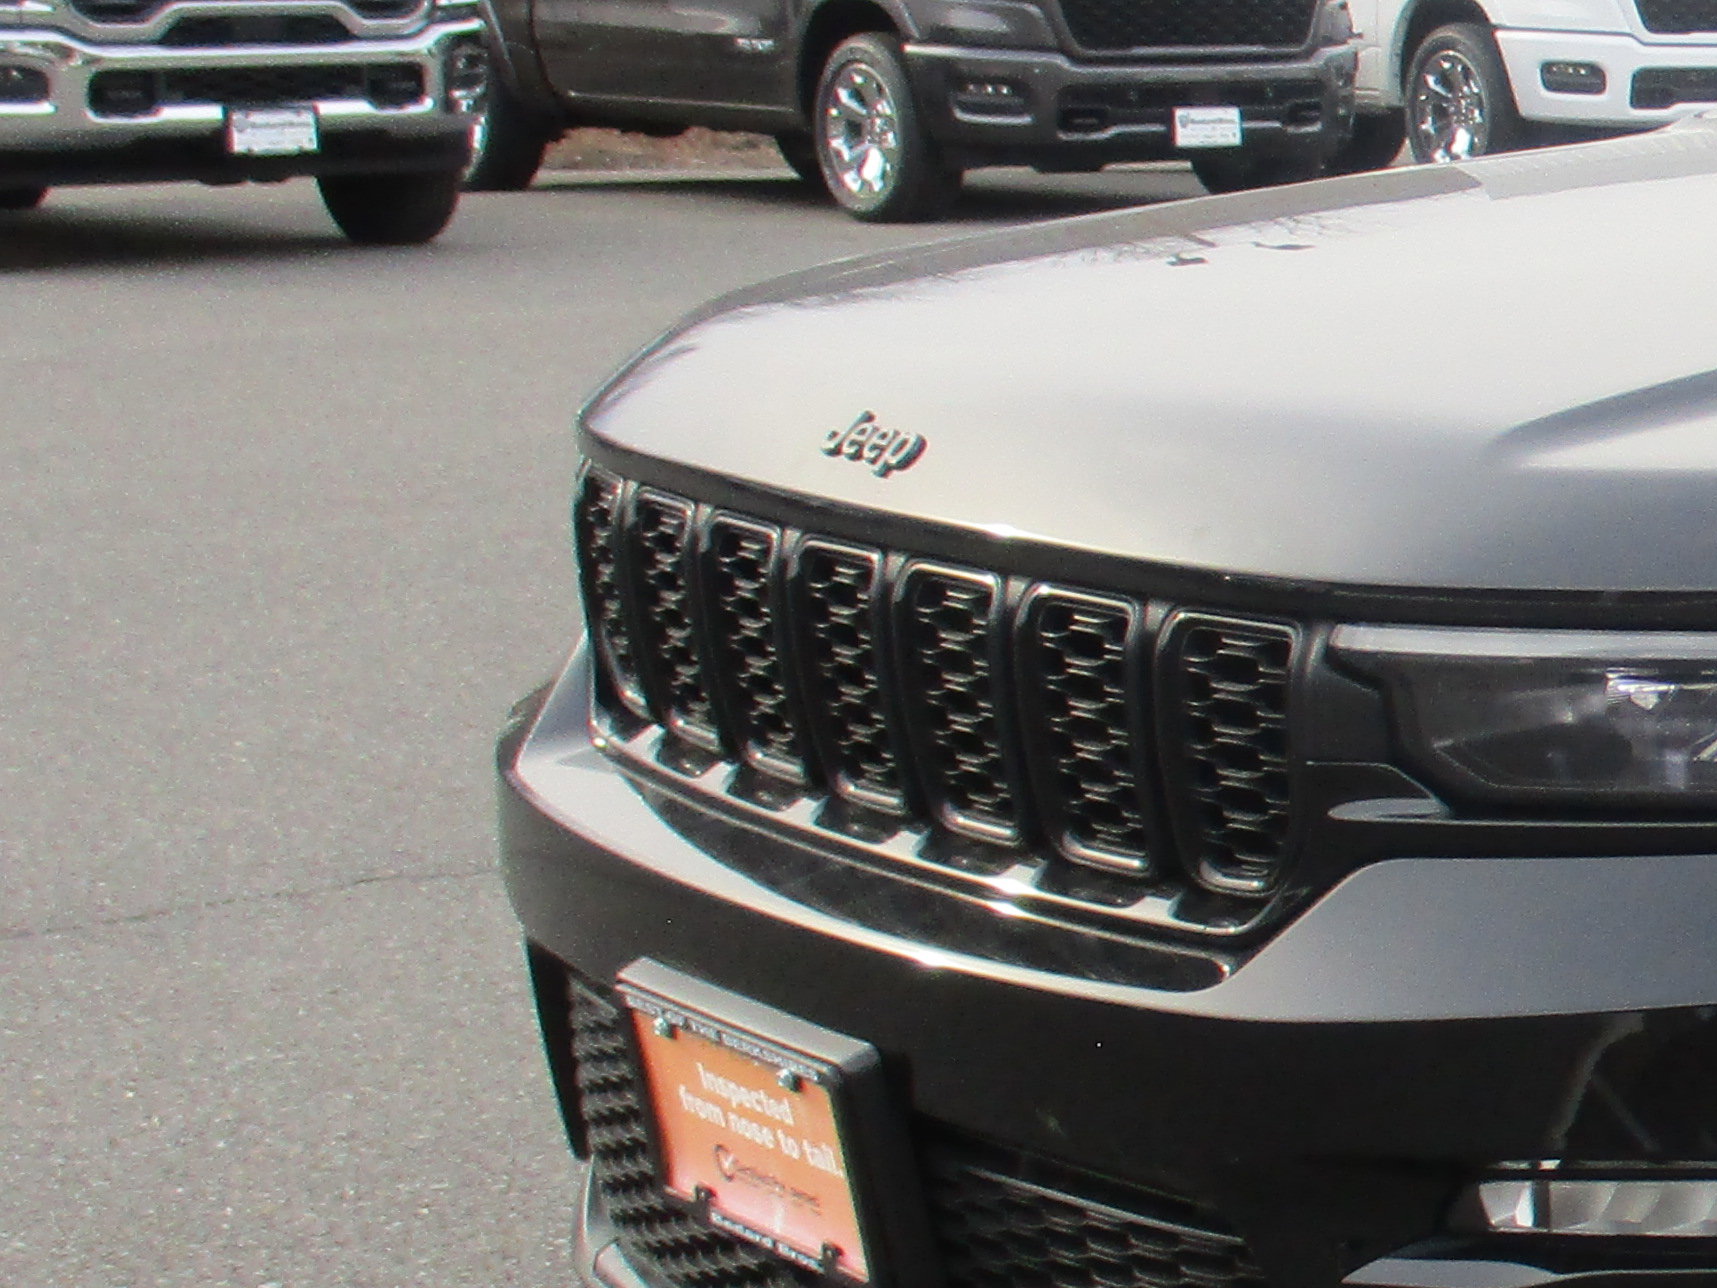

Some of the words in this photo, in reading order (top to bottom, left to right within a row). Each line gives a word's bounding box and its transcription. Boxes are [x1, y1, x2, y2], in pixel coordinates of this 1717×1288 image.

[820, 410, 928, 479] Jeep
[679, 1084, 727, 1129] from
[727, 1110, 775, 1150] nose
[776, 1127, 801, 1161] to
[697, 1062, 795, 1127] Inspected
